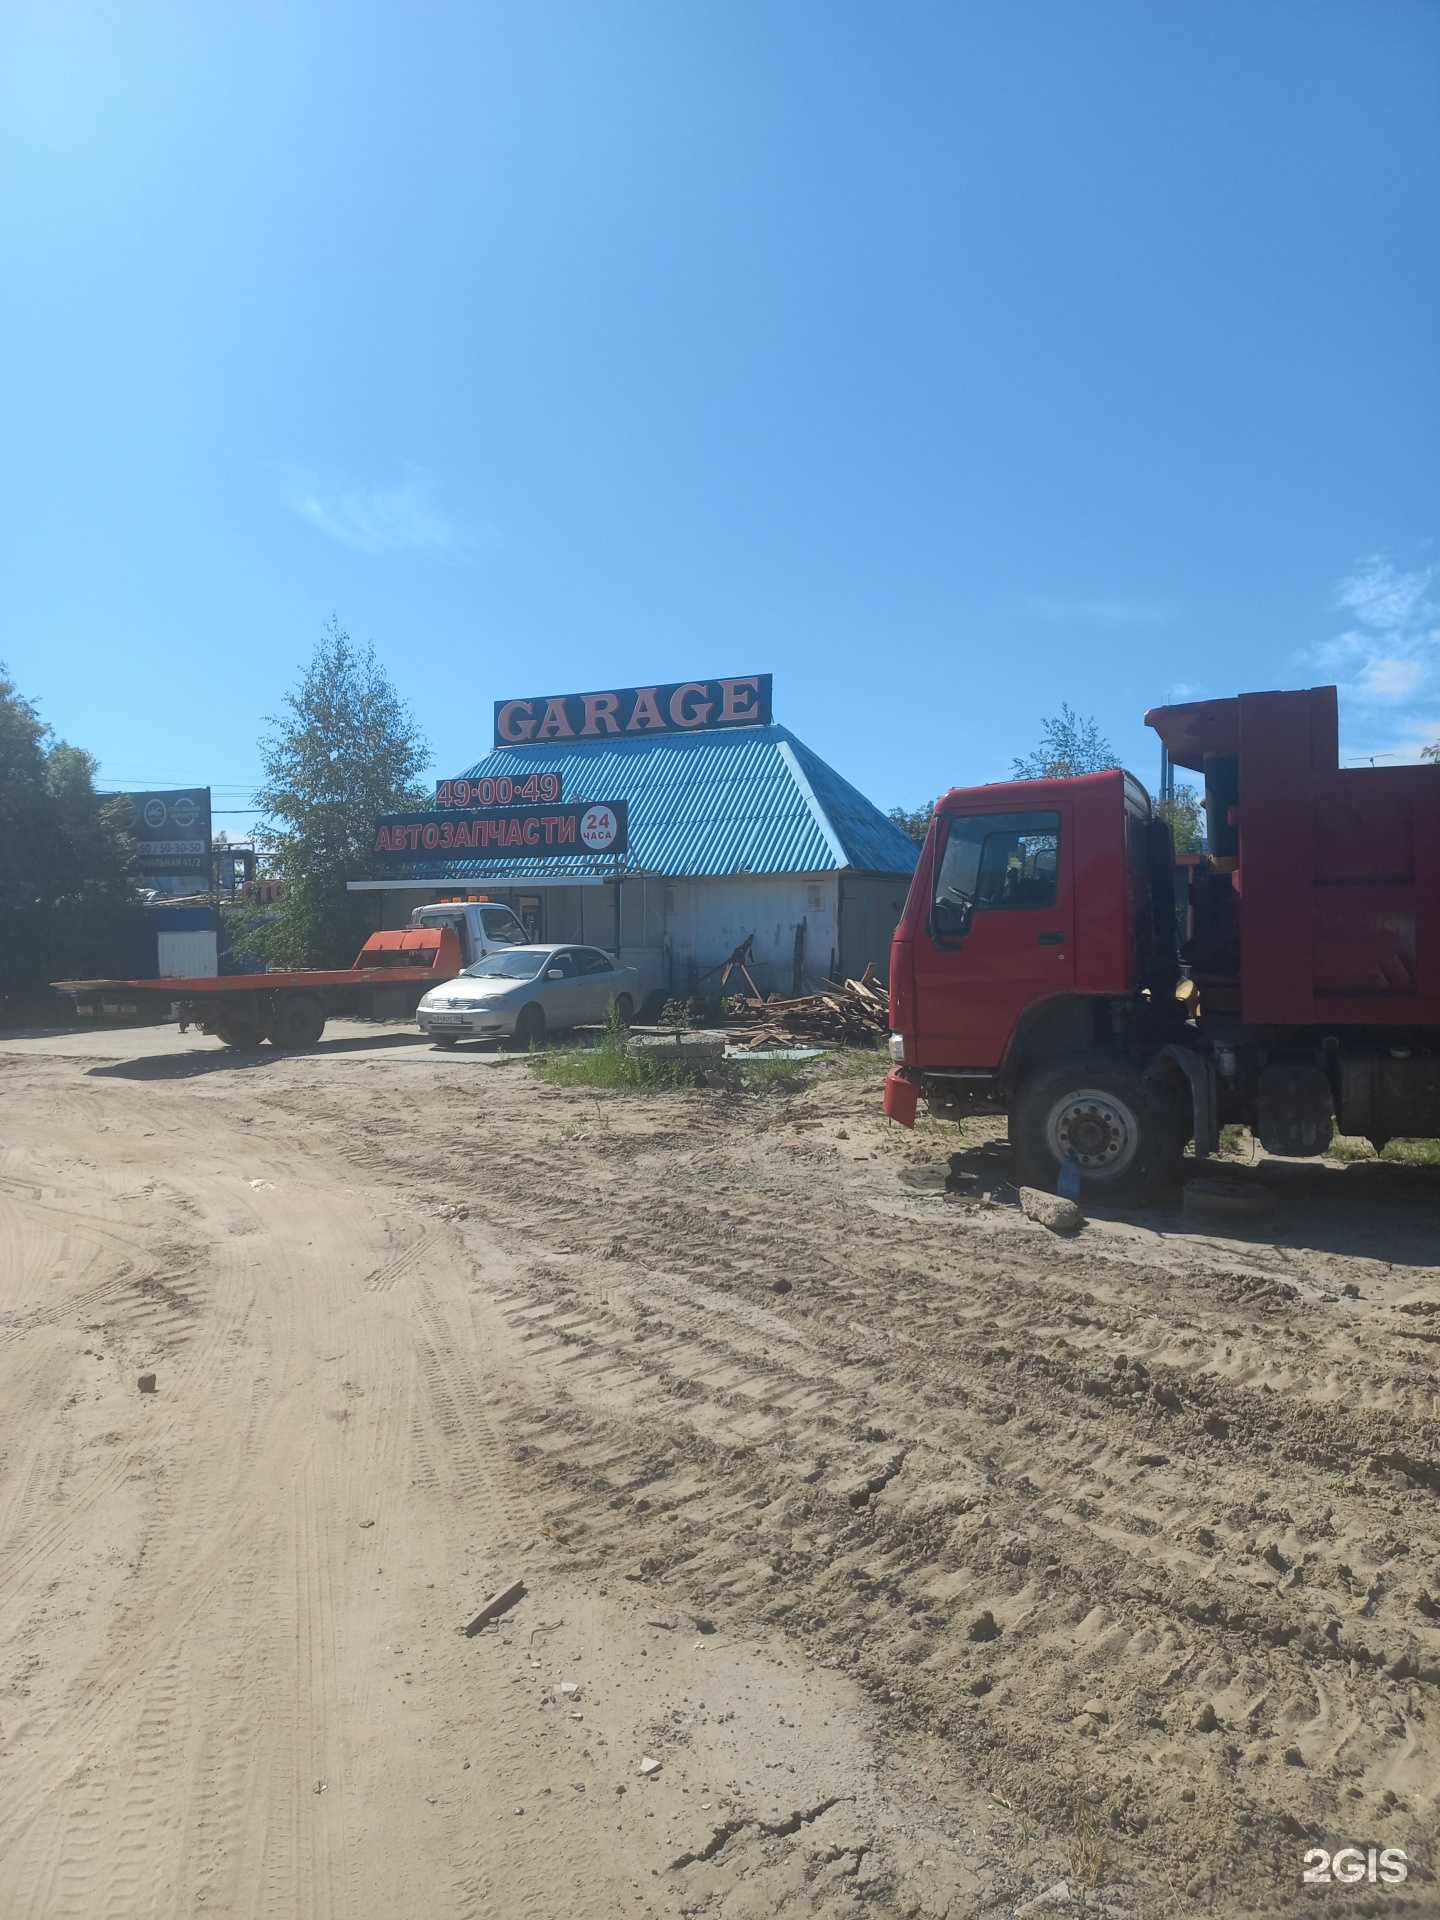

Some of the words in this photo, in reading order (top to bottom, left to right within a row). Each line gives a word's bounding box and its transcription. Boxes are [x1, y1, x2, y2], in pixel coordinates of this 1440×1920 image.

[497, 678, 759, 742] GARAGE
[376, 815, 577, 851] АВТОЗАПЧАСТИ
[586, 813, 609, 830] 24
[583, 831, 612, 841] ЧАСА
